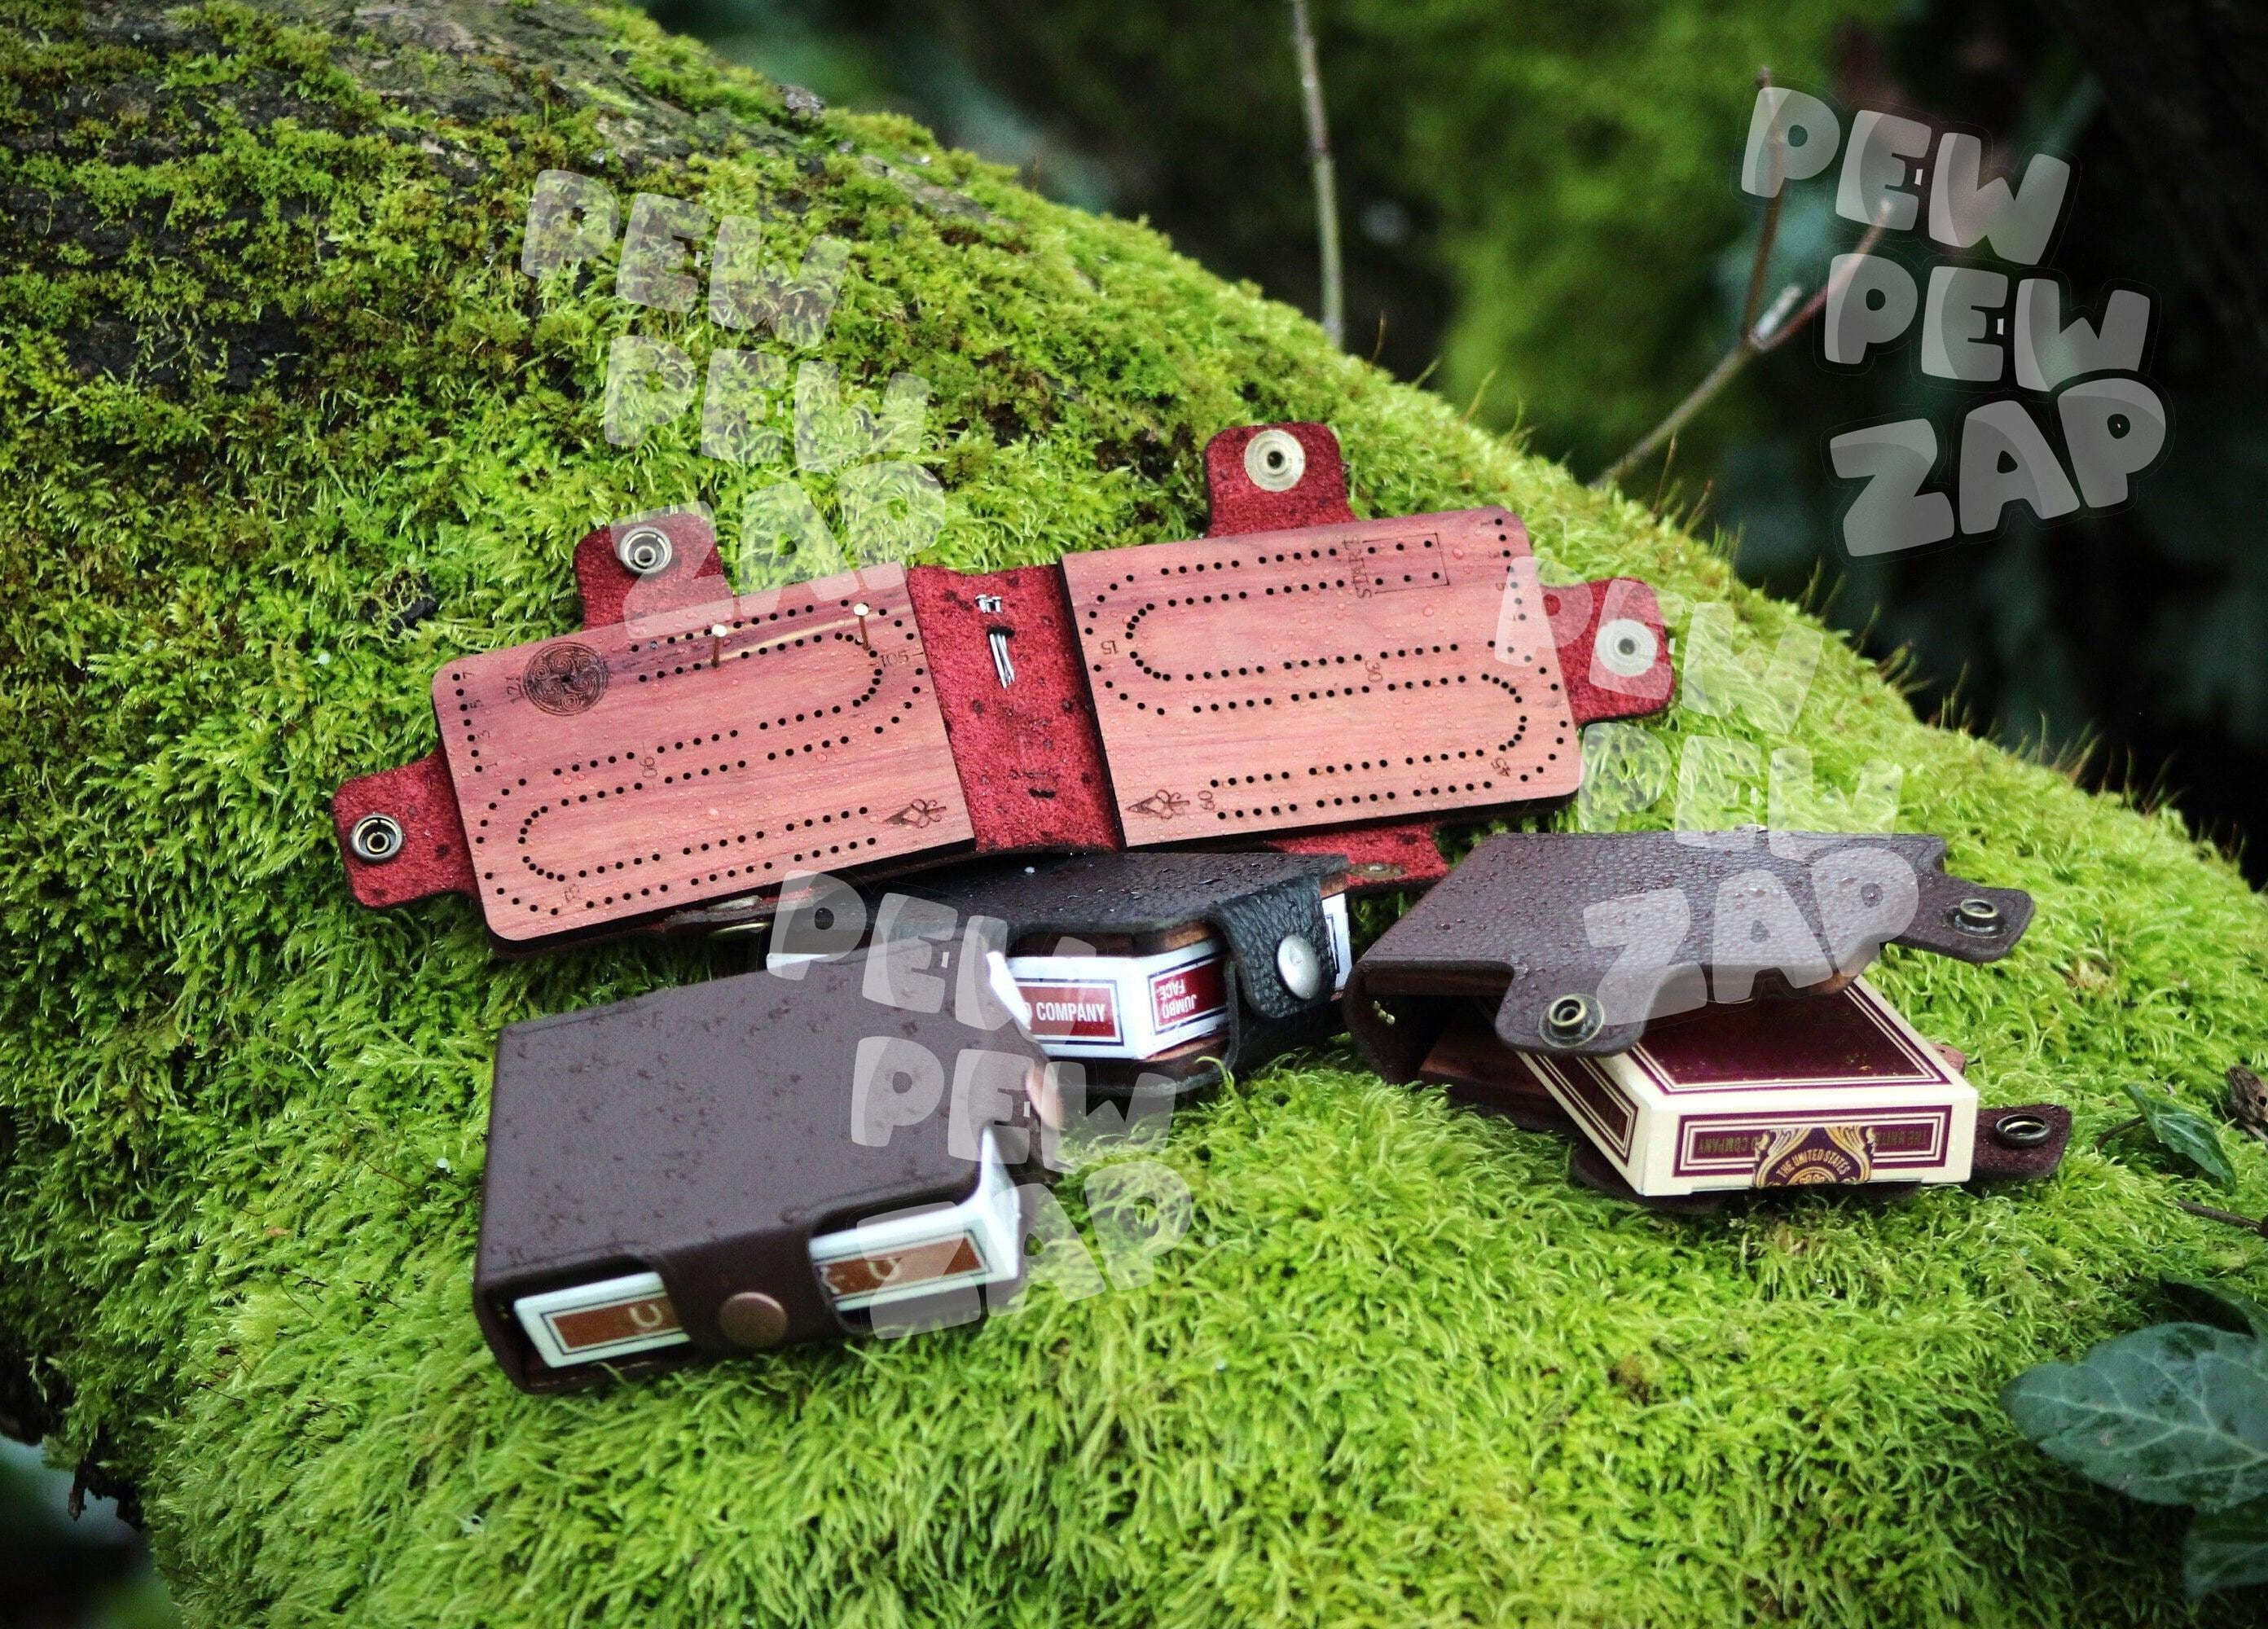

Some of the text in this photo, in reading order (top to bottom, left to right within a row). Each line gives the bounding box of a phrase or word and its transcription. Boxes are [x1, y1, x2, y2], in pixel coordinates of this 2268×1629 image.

[1158, 978, 1186, 1001] FACE
[1035, 1001, 1105, 1023] COMPANY
[1162, 994, 1198, 1019] JUMBO
[1776, 1148, 1851, 1178] THE UNITED STATES
